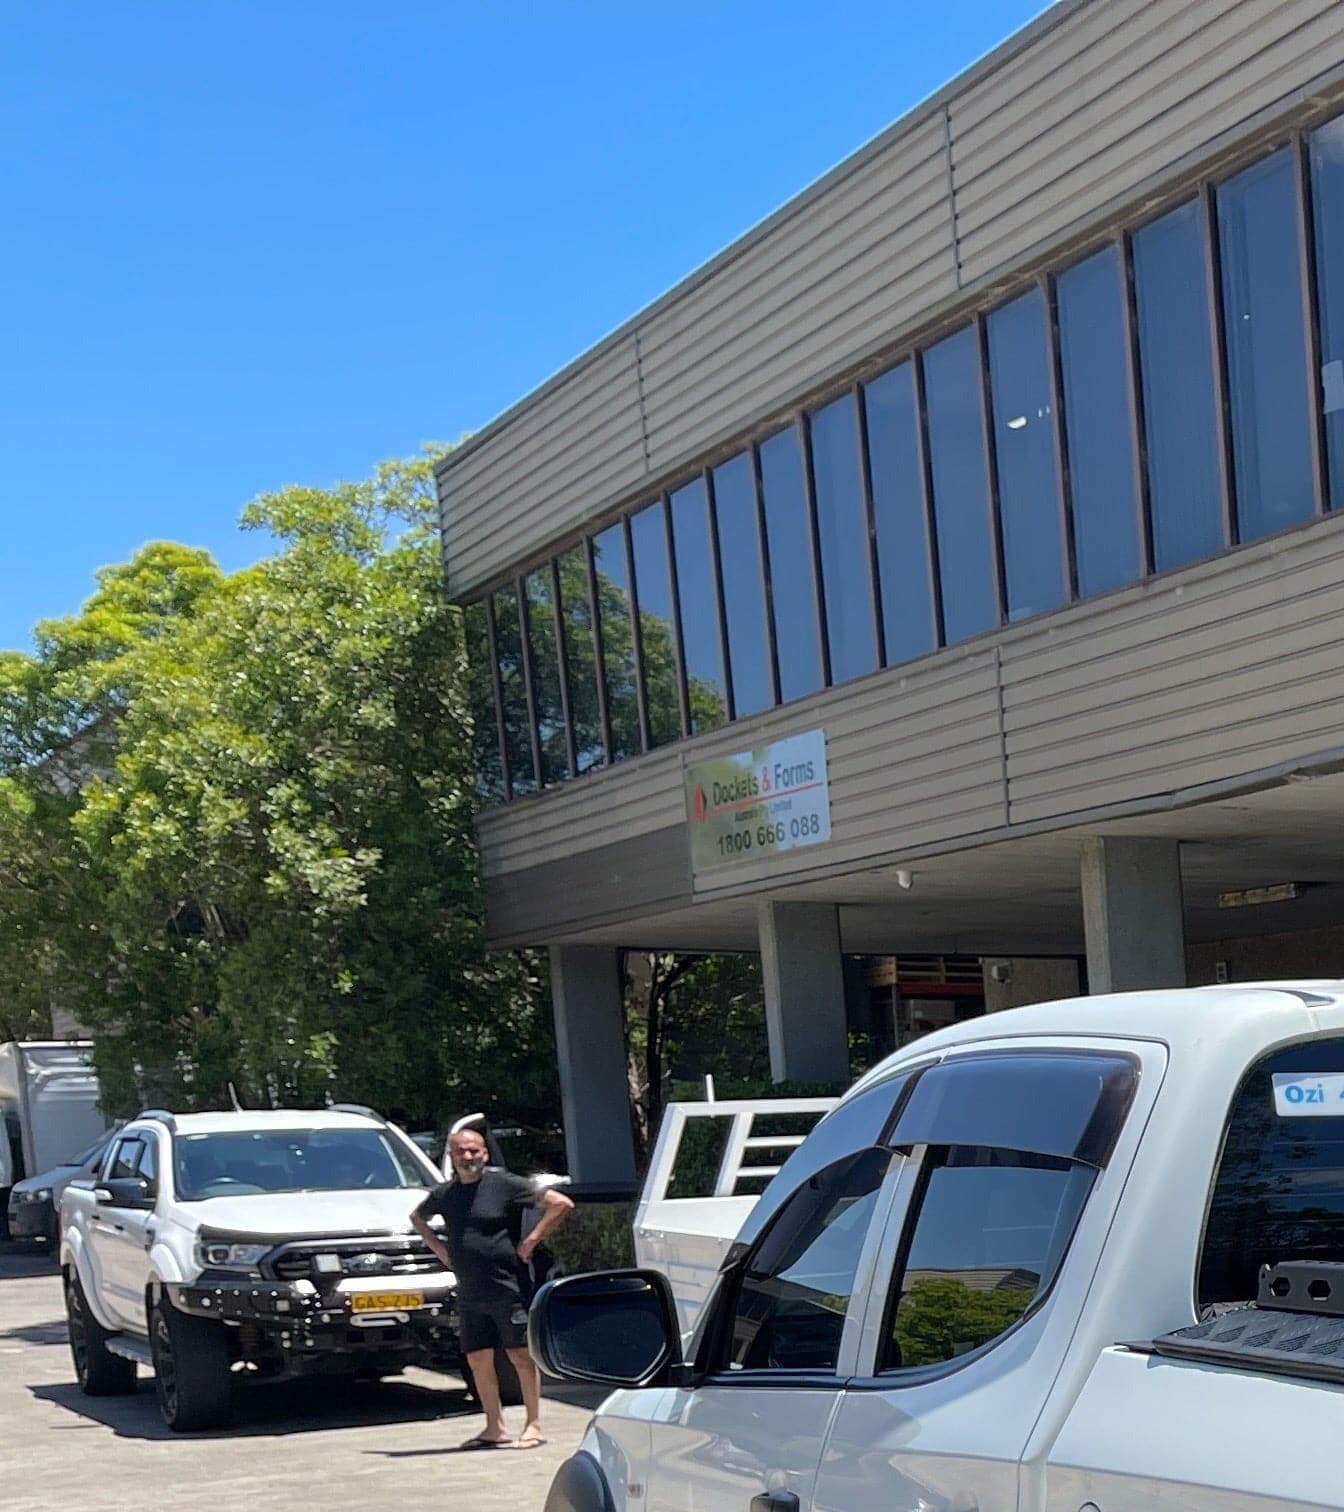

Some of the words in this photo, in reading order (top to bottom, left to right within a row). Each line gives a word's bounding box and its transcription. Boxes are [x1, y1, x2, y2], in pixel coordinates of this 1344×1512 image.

[713, 774, 759, 806] Dockets
[761, 766, 772, 793] &
[774, 760, 815, 790] Forms
[717, 829, 751, 856] 1800
[757, 822, 786, 847] 666
[790, 813, 820, 838] 088
[1284, 1083, 1325, 1104] Ozi
